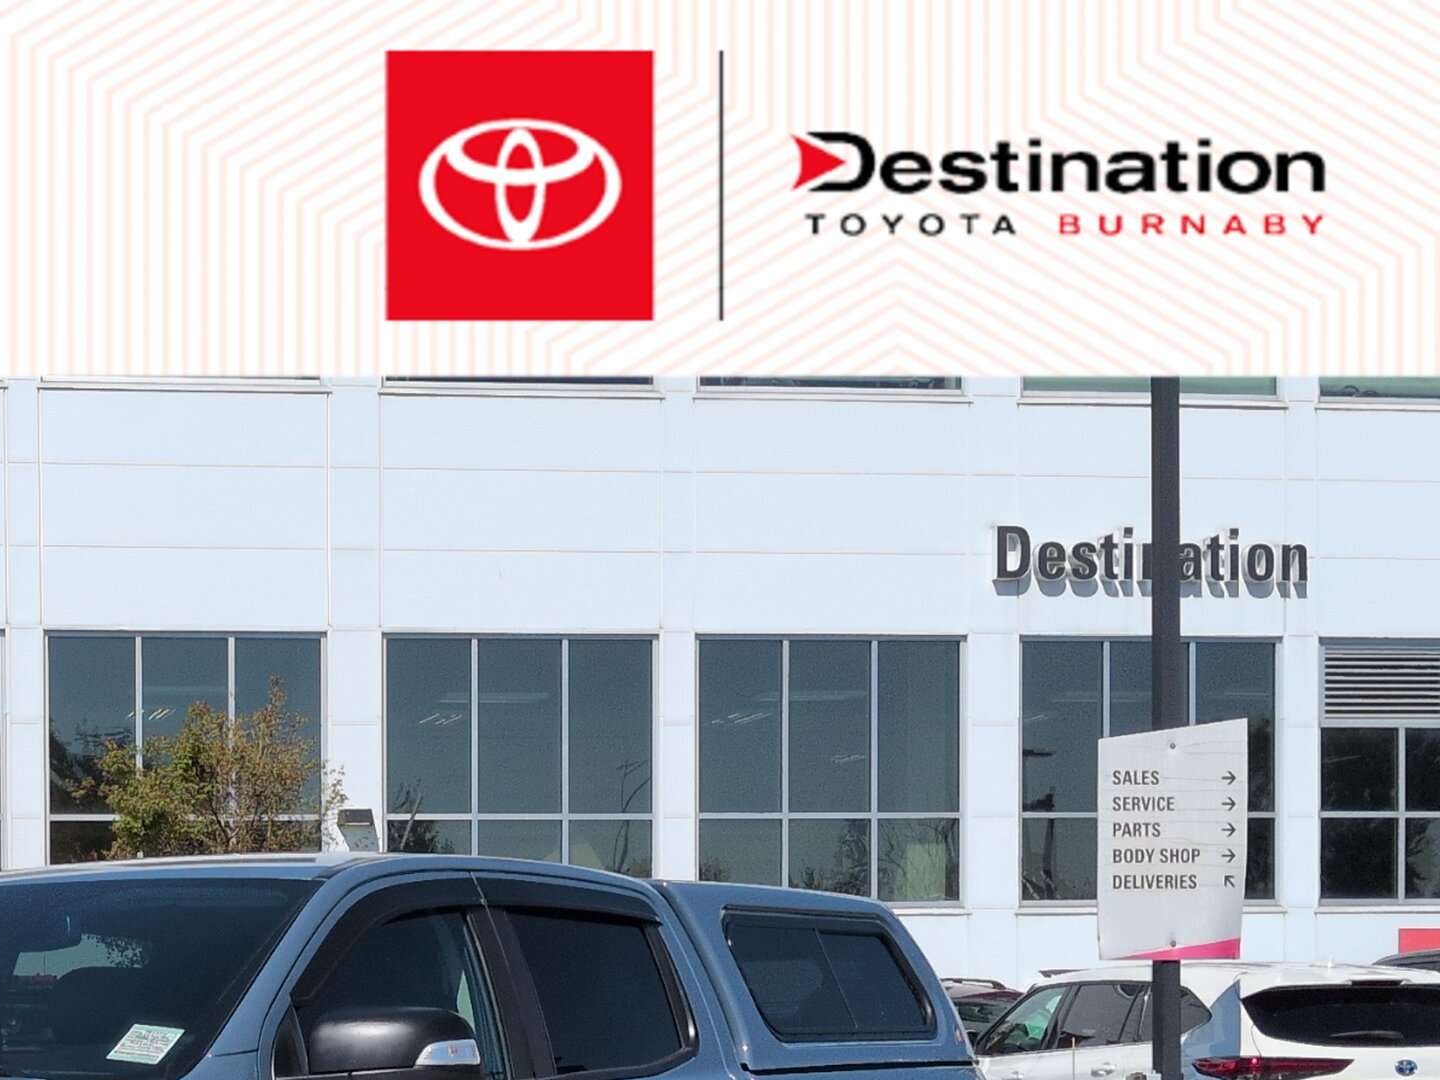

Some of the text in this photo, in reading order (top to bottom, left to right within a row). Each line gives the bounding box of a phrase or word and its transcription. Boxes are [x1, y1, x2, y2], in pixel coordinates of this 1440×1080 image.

[1112, 770, 1160, 786] SALES
[1112, 796, 1175, 812] SERVICE
[1112, 822, 1161, 838] PARTS
[1112, 848, 1201, 864] BODY SHOP
[1112, 874, 1198, 890] DELIVERIES
